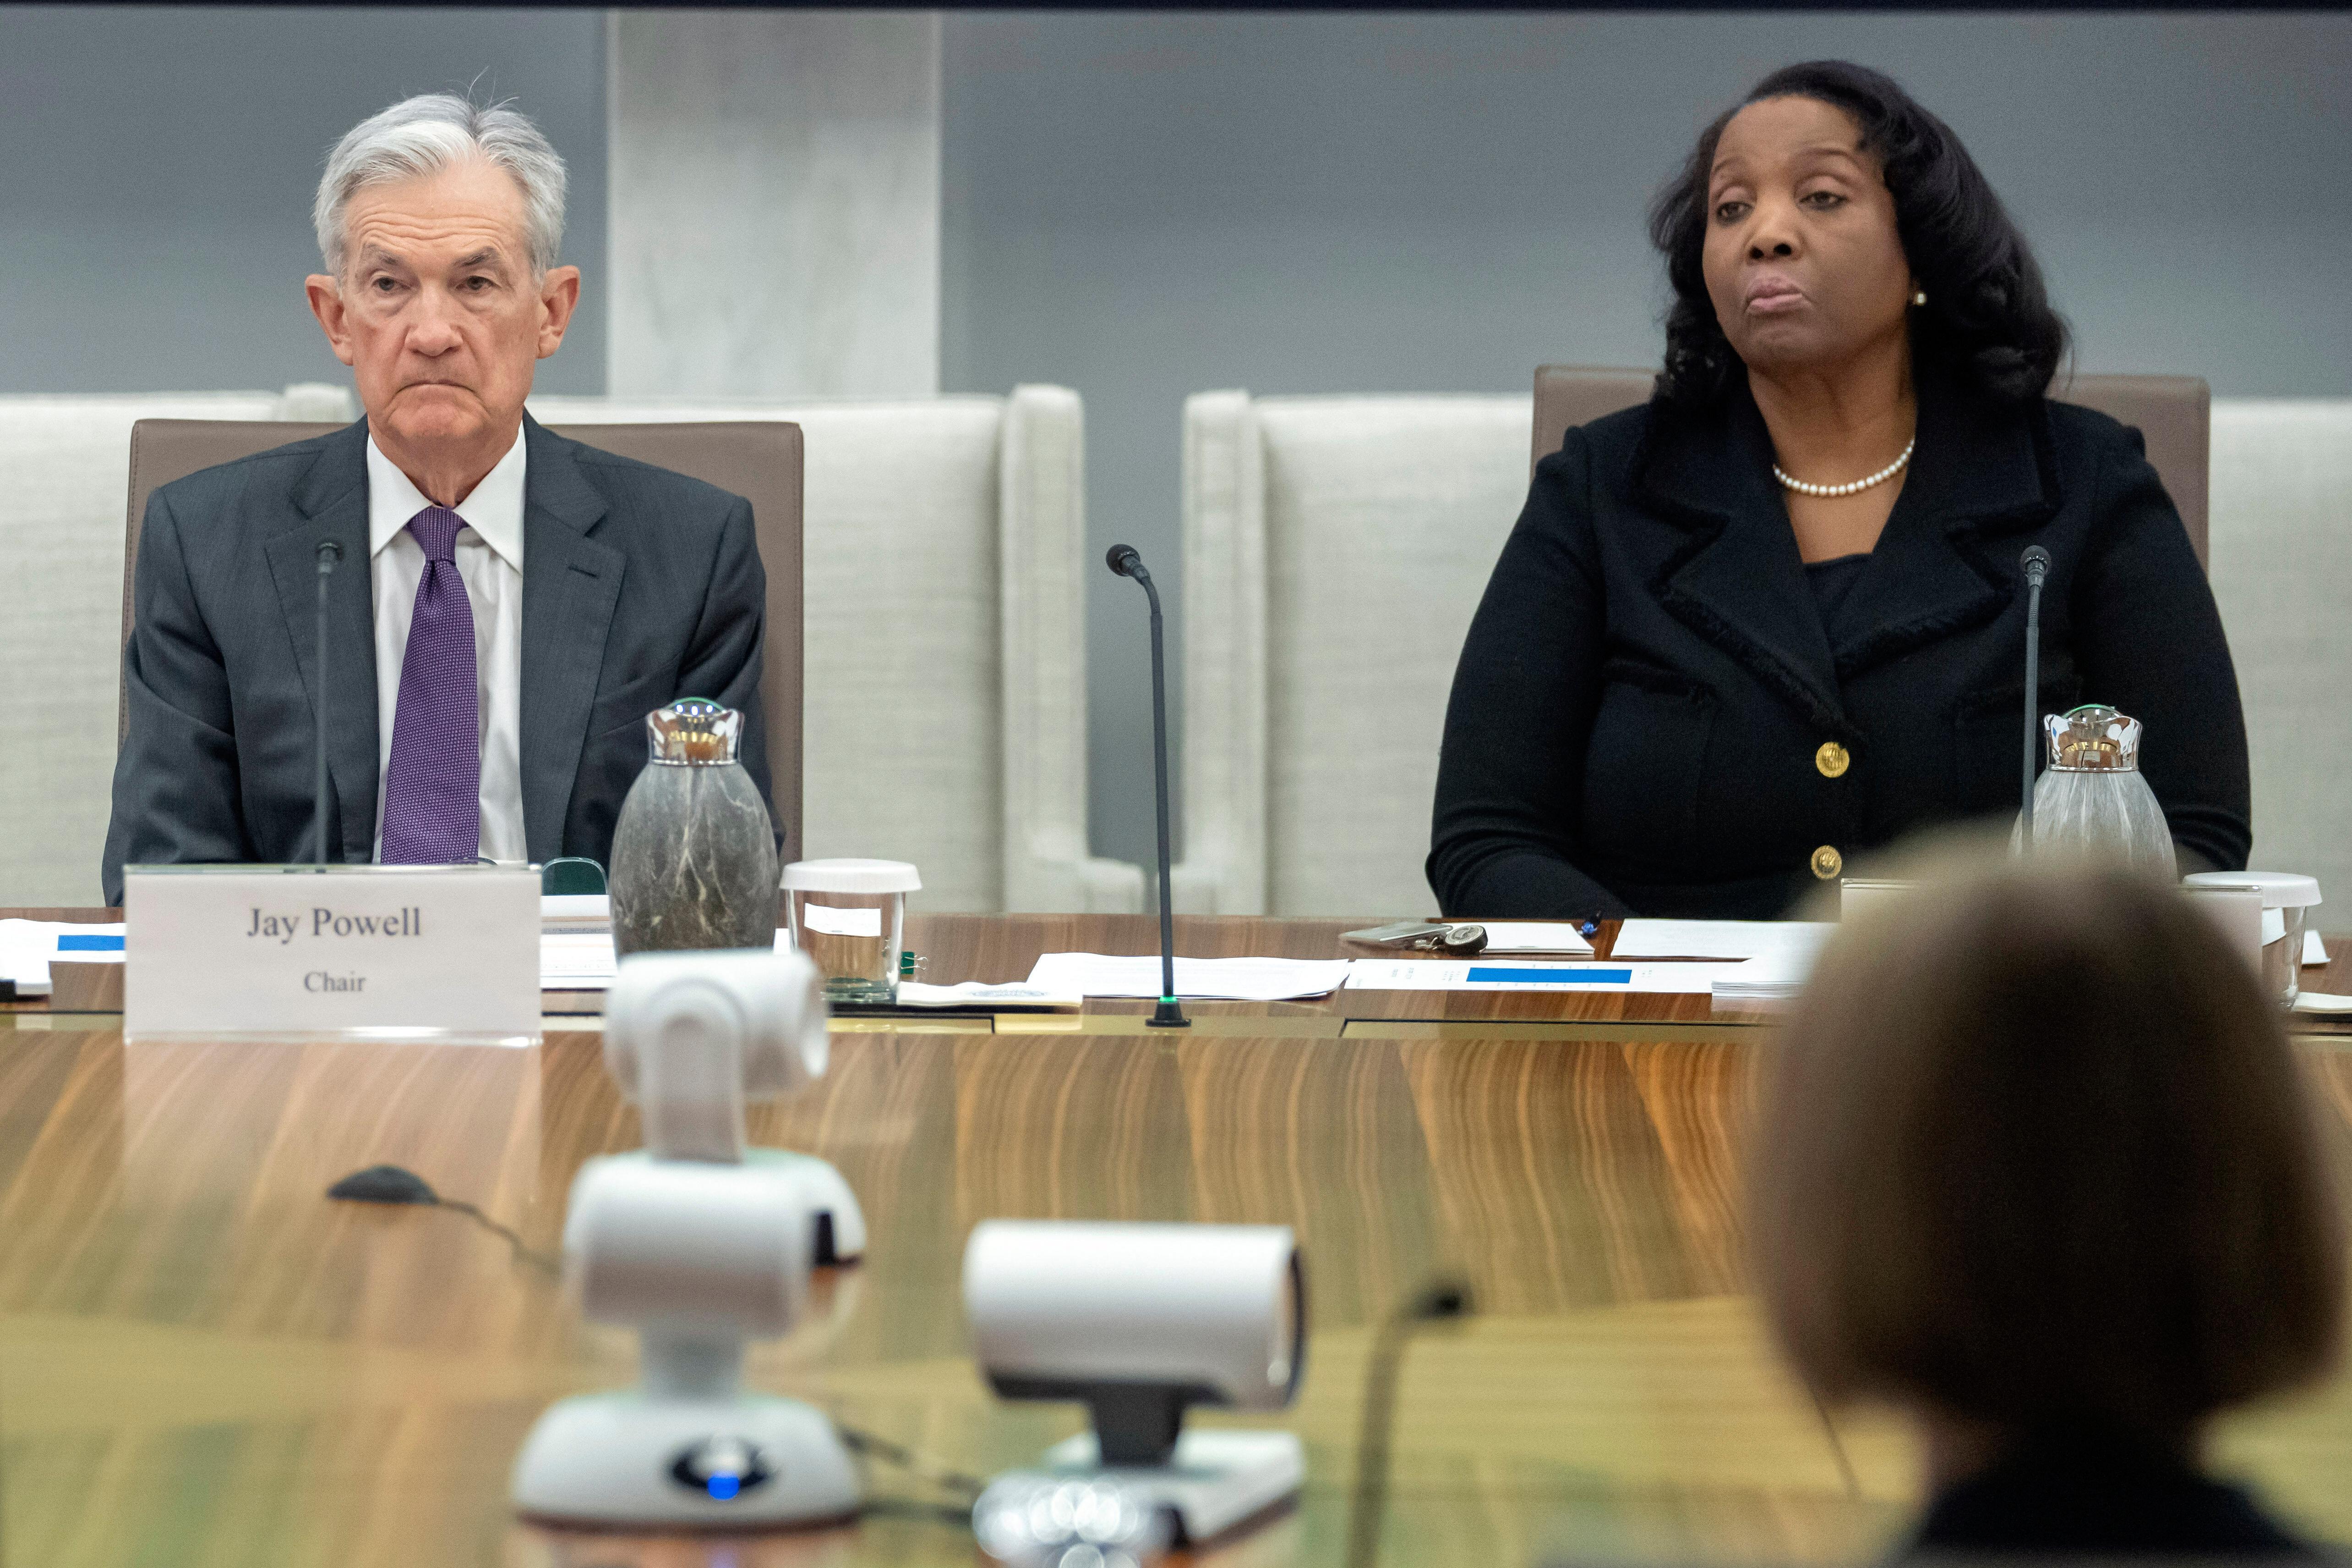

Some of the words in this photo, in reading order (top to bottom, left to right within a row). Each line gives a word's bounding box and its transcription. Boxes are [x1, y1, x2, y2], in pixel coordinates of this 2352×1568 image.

[247, 907, 300, 945] Jay
[312, 907, 421, 938] Powell
[303, 972, 367, 993] Chair
